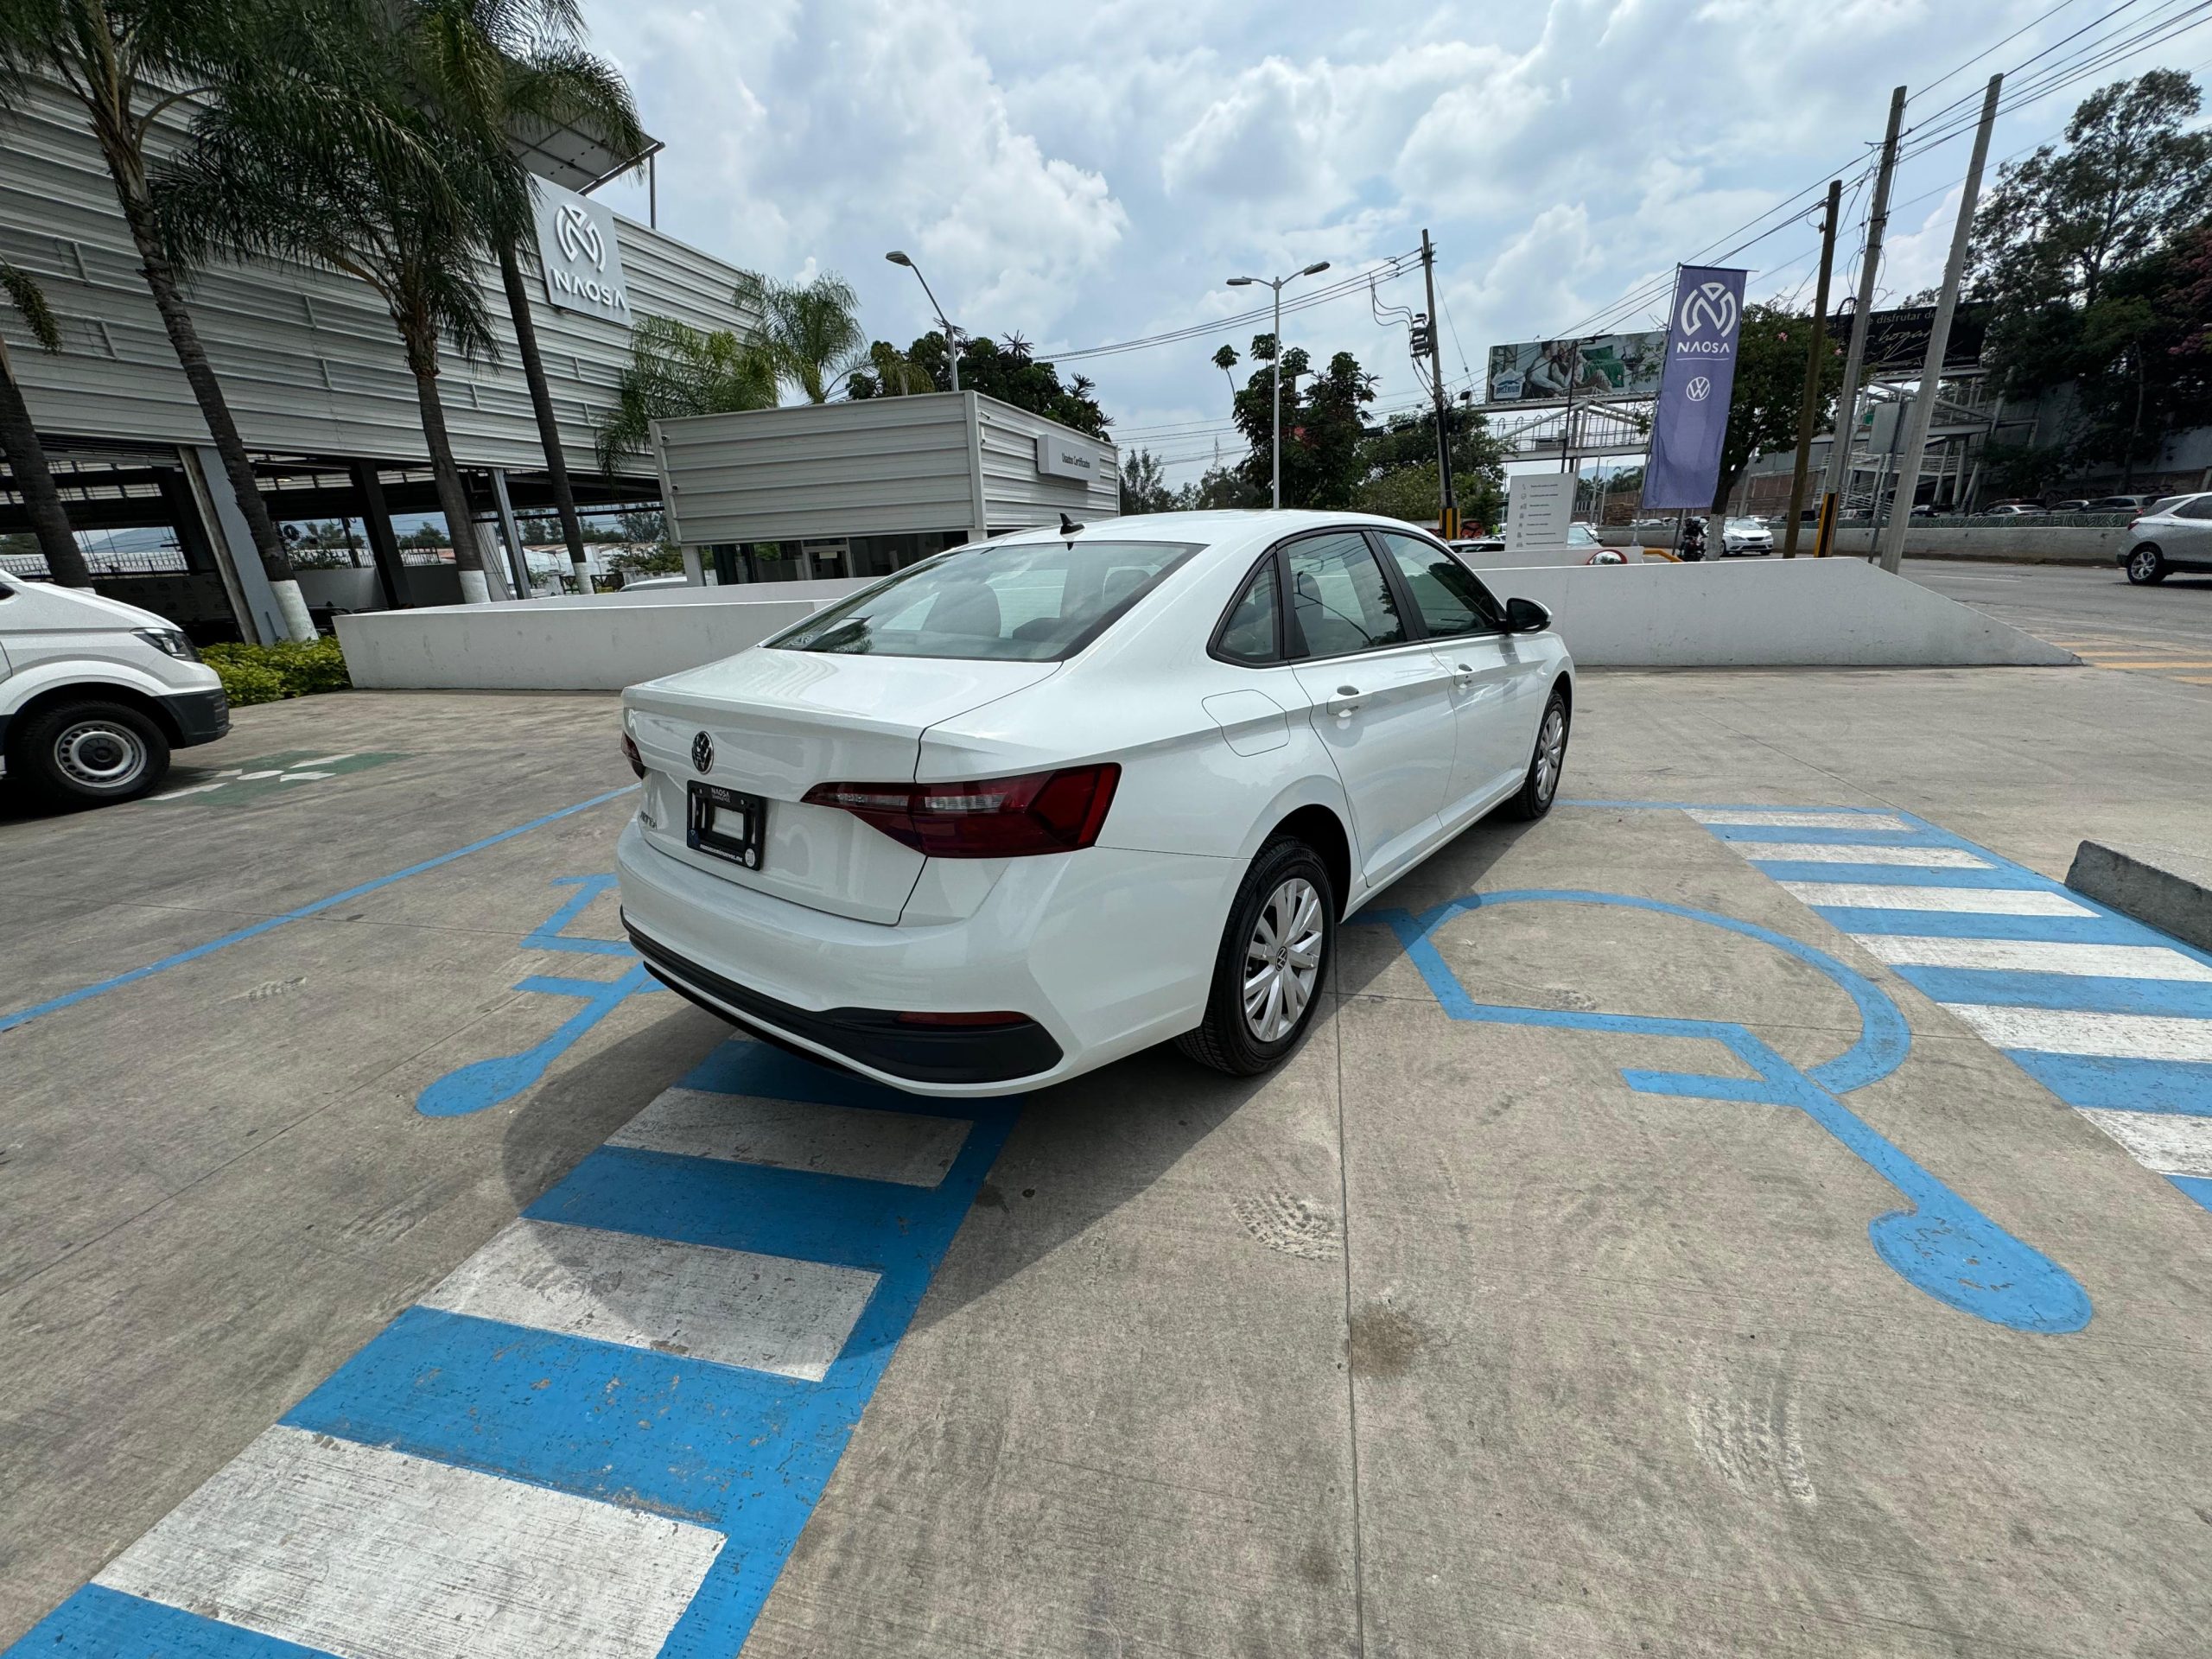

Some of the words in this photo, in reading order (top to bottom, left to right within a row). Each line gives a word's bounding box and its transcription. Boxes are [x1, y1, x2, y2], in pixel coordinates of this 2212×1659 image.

[551, 267, 626, 309] NAOSA
[1877, 312, 1922, 325] disfrutar
[1676, 340, 1730, 353] NAOSA
[711, 788, 730, 798] NAOSA
